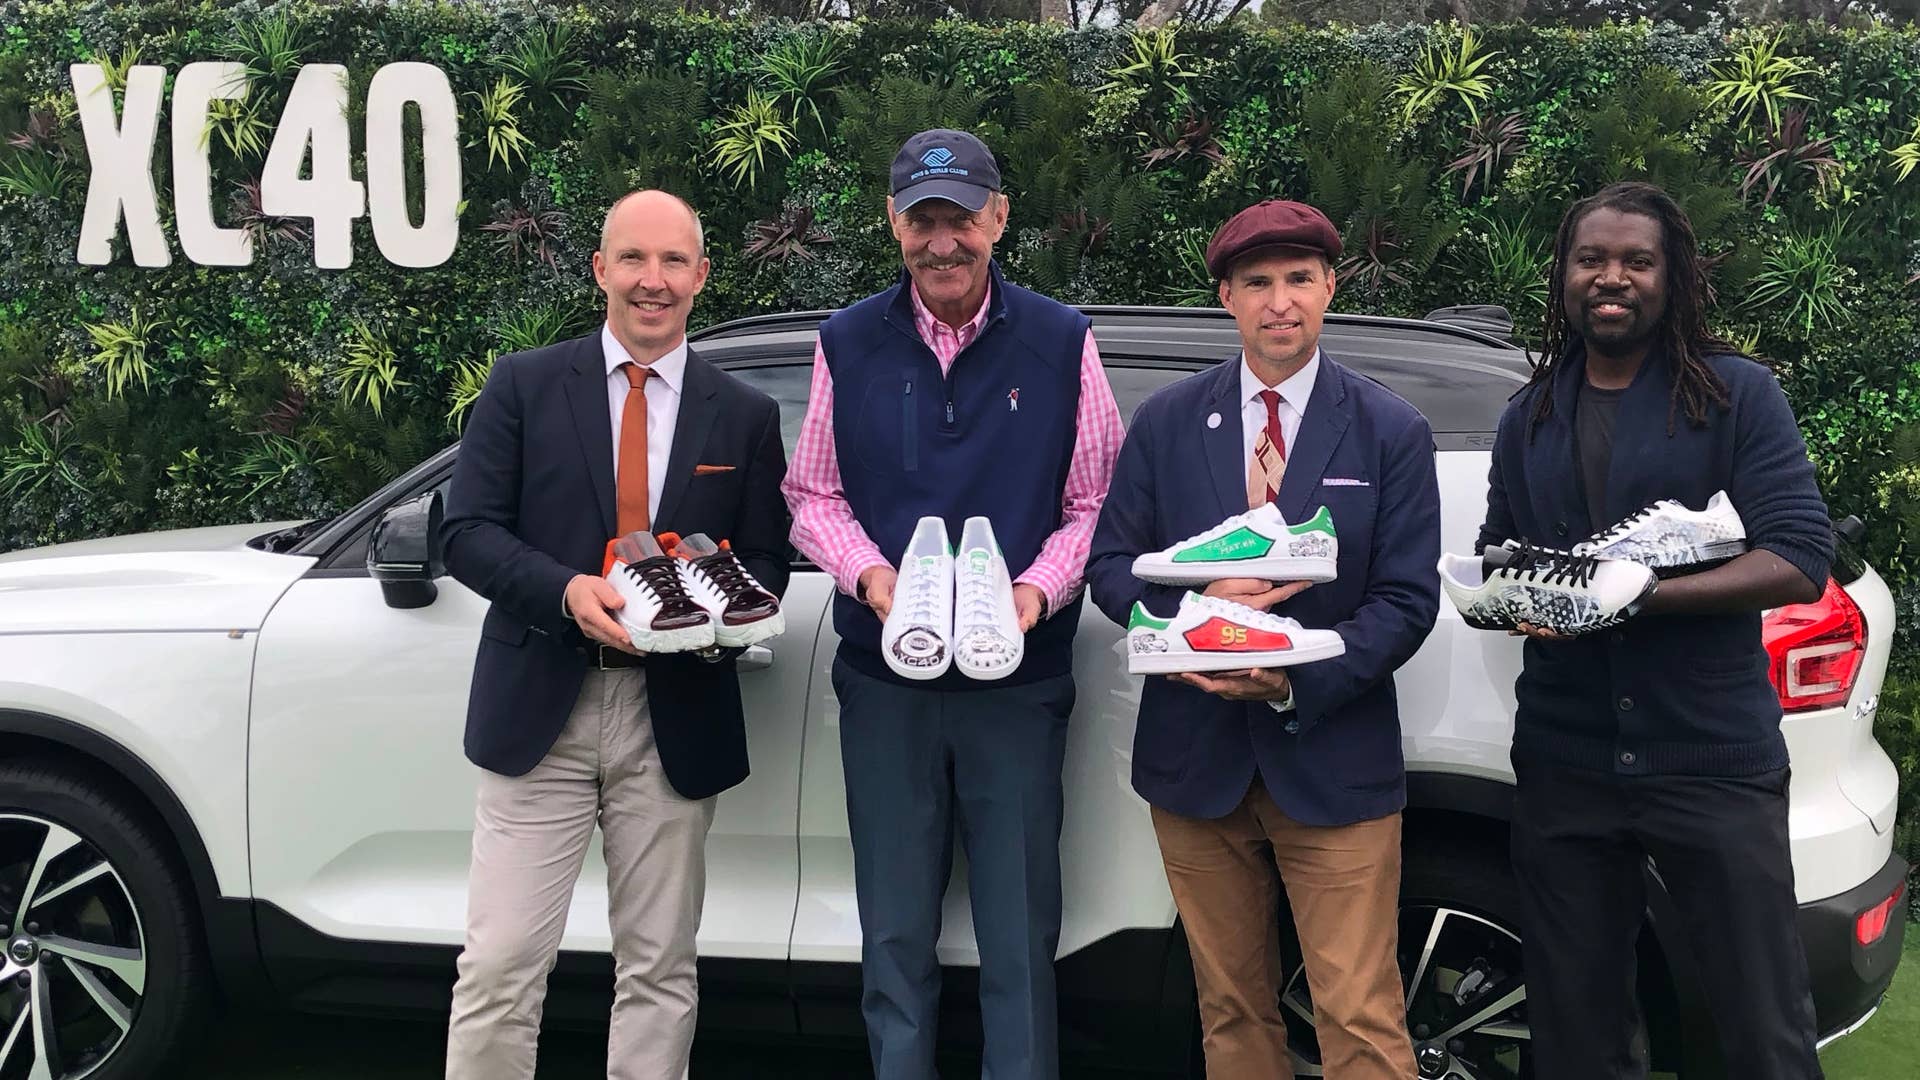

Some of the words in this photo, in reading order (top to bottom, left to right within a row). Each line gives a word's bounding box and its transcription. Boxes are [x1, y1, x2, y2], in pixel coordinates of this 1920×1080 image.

[70, 61, 463, 269] XC40
[1220, 626, 1248, 646] 95
[899, 654, 940, 666] XC40
